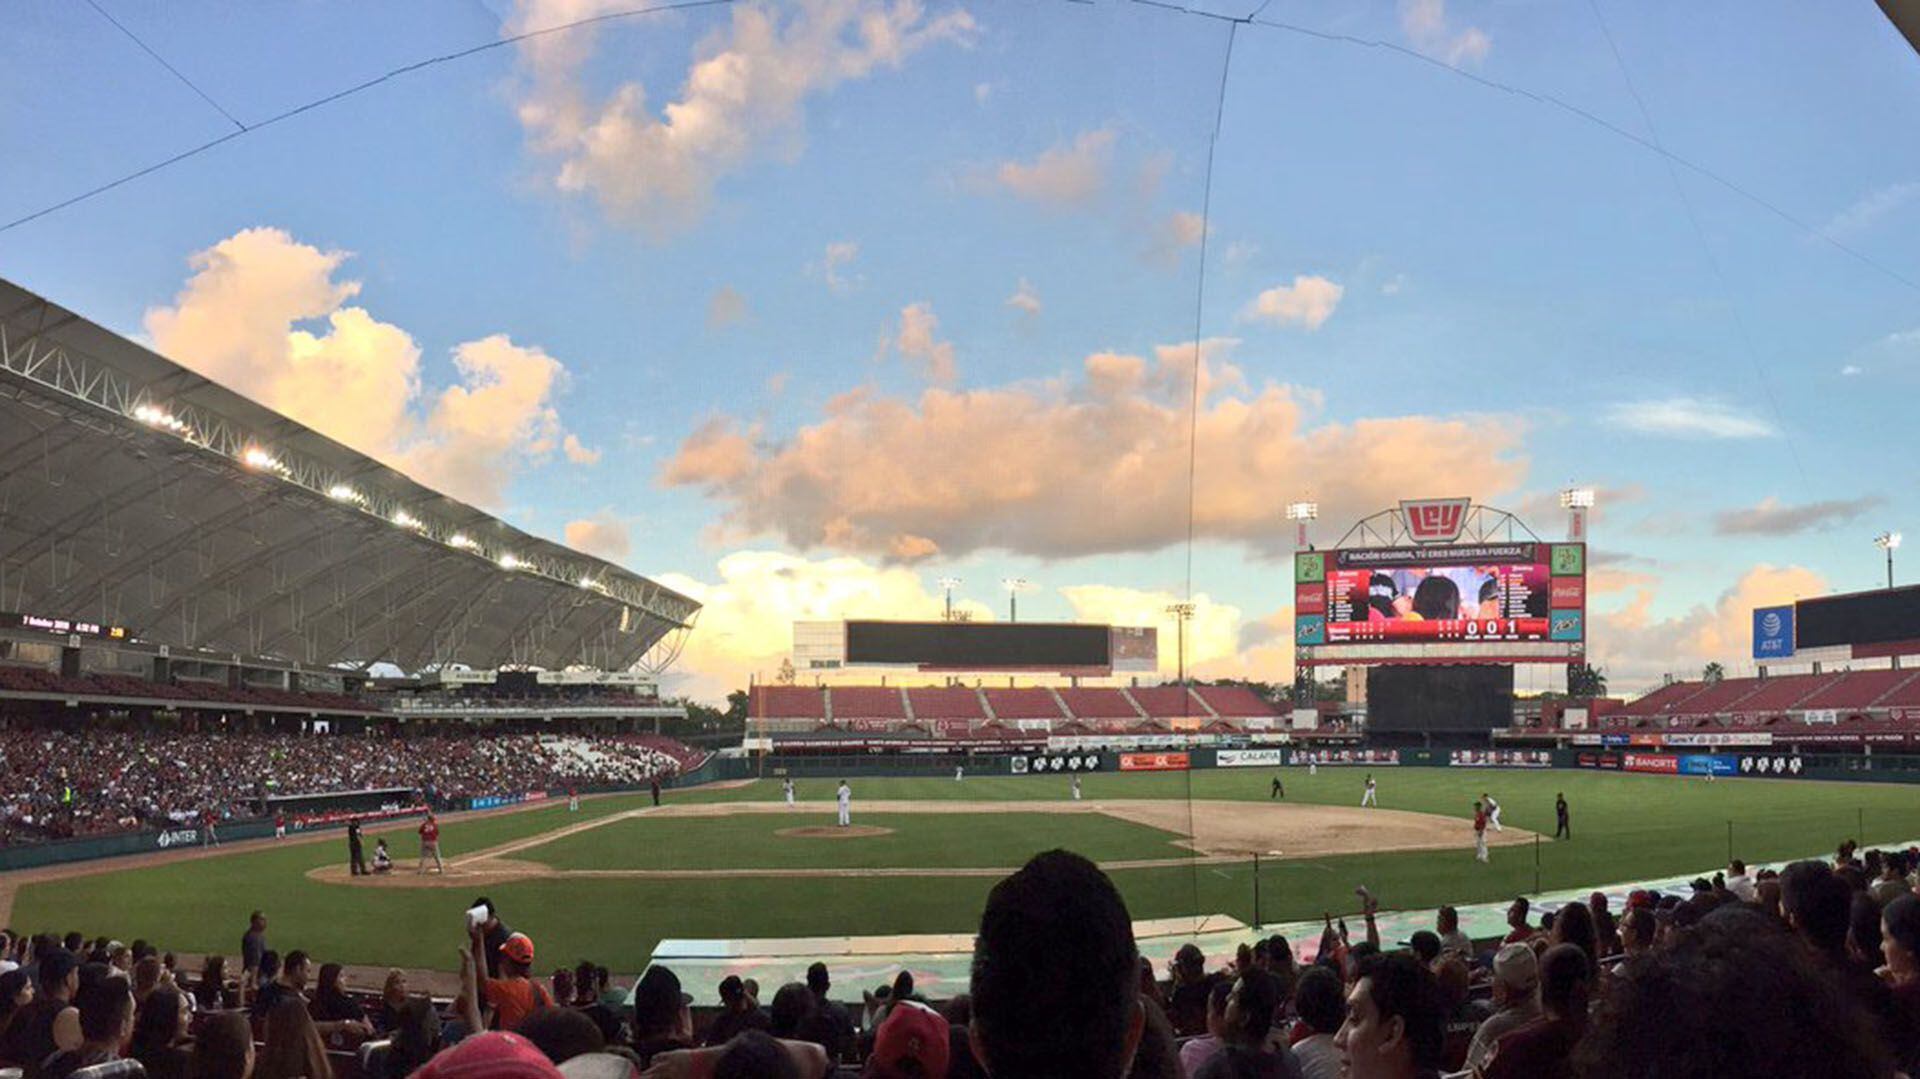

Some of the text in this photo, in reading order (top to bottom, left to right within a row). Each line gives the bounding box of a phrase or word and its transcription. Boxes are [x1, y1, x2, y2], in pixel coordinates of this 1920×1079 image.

[1466, 621, 1477, 635] 0
[1486, 620, 1497, 635] 0
[1507, 619, 1516, 634] 1
[1760, 639, 1783, 651] AT&T
[1635, 757, 1678, 770] BANORTE
[171, 829, 198, 843] INTER
